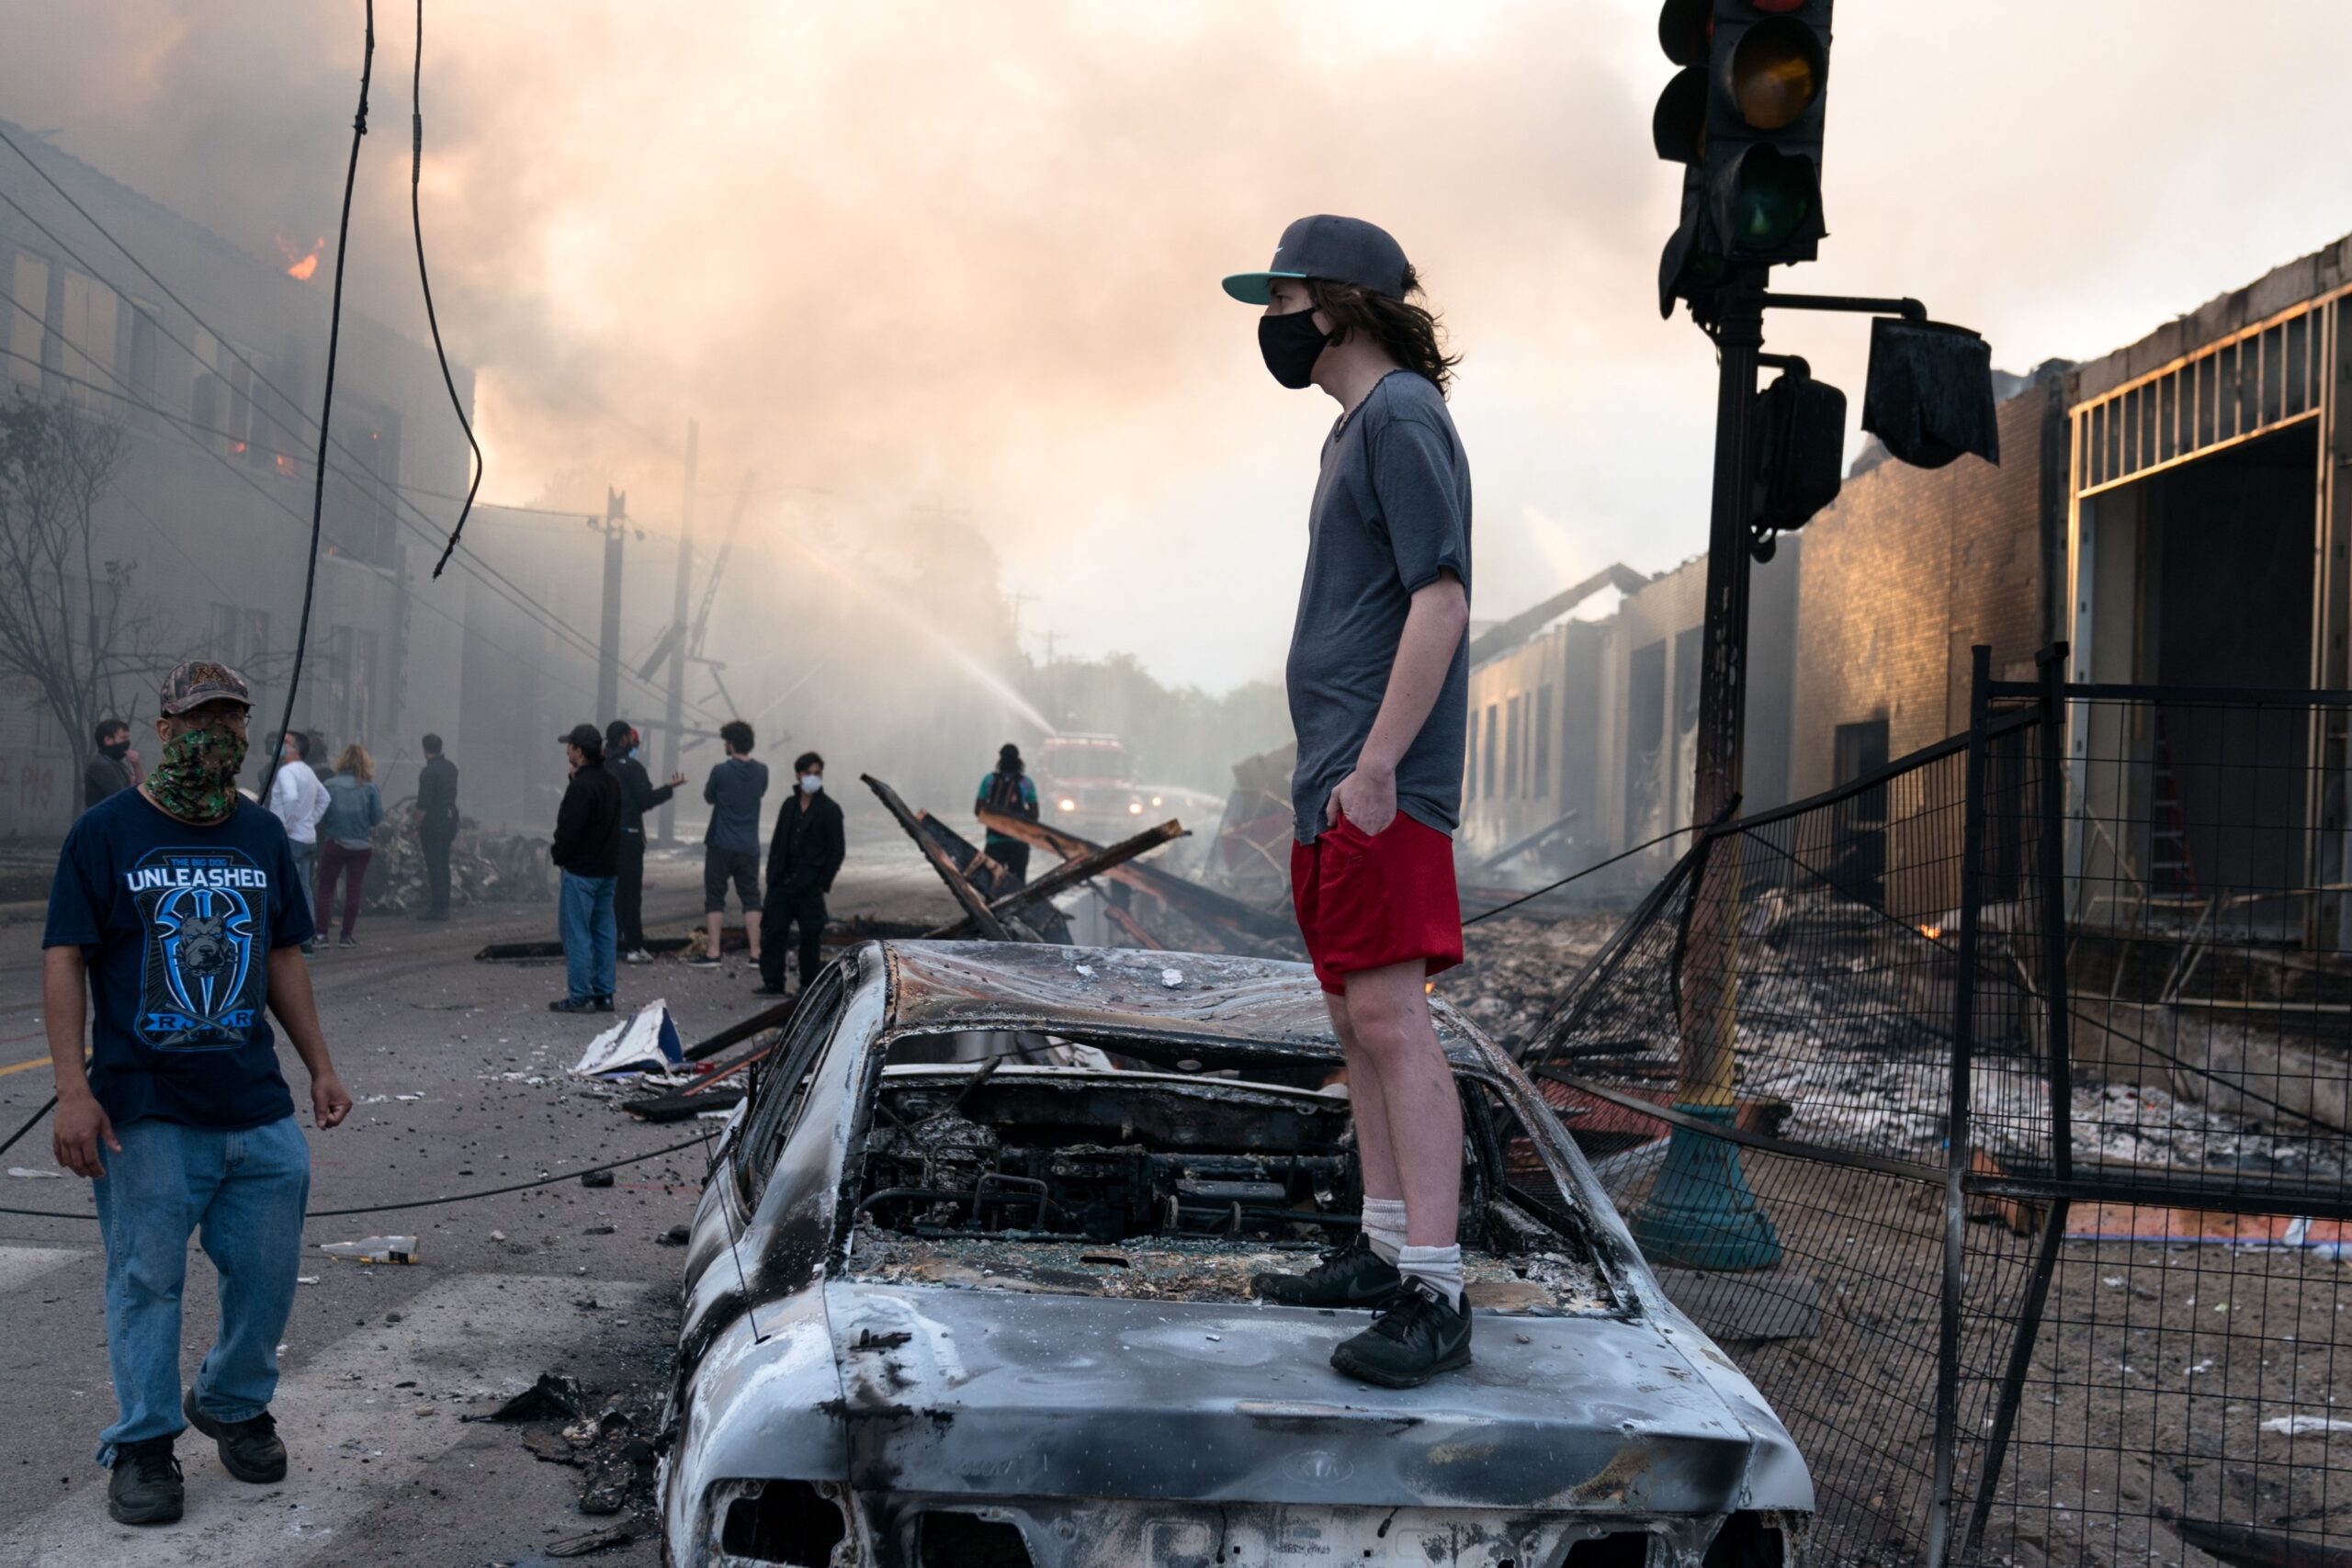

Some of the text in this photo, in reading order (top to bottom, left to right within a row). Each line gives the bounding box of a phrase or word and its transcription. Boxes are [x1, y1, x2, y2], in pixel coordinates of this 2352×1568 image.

[127, 868, 267, 892] UNLEASHED
[158, 1012, 250, 1029] R R
